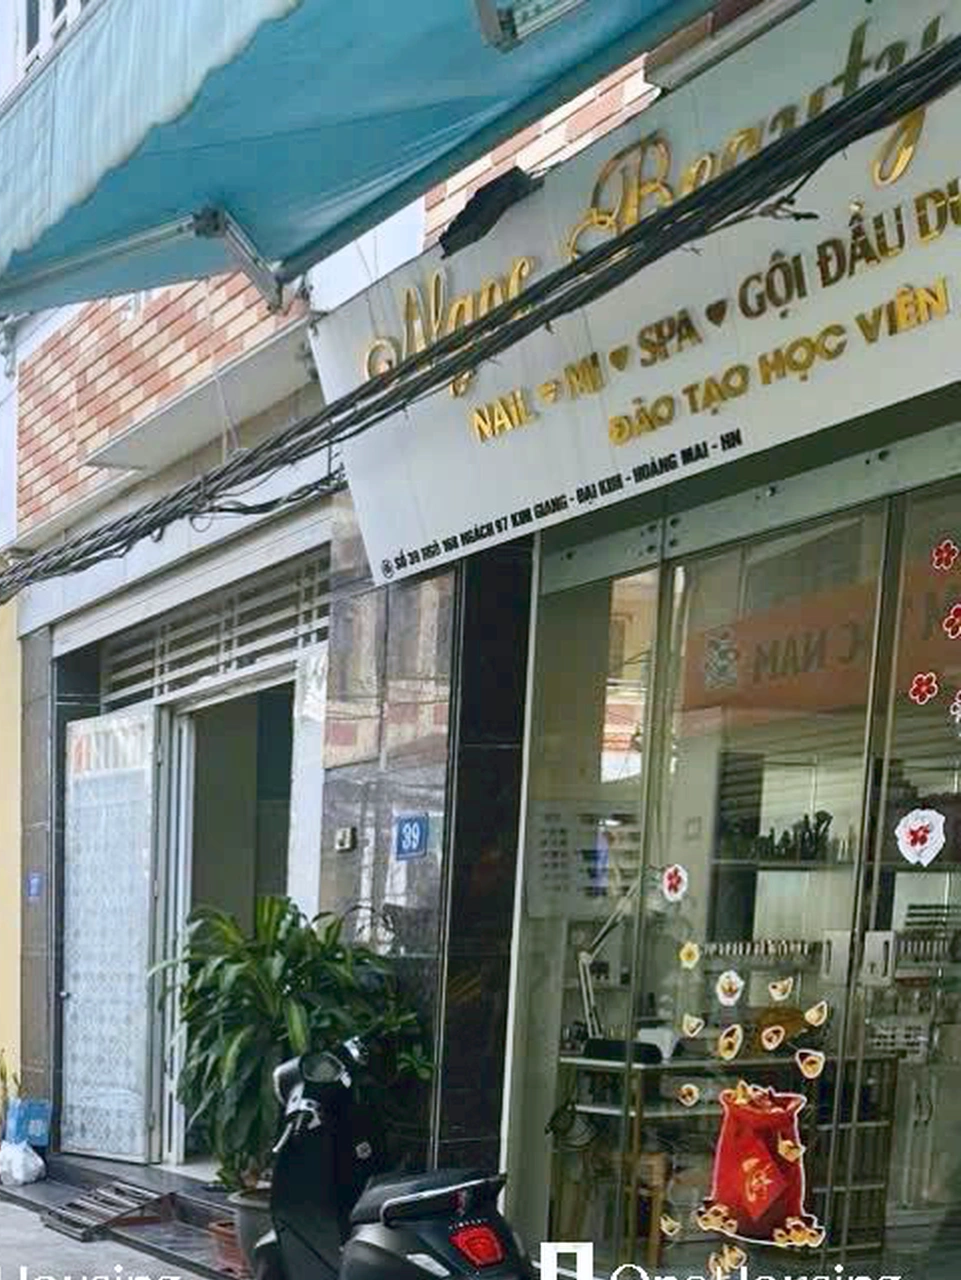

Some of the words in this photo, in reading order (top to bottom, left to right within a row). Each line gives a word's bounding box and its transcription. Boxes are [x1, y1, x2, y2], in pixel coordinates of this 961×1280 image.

[471, 388, 535, 443] NAIL
[637, 308, 703, 367] SPA
[738, 249, 808, 319] GỘI
[608, 396, 675, 446] ĐÀO
[681, 364, 750, 416] TẠO
[757, 323, 848, 386] HỌC
[854, 274, 951, 345] VIÊN
[680, 440, 709, 466] MAI
[402, 822, 420, 850] 39
